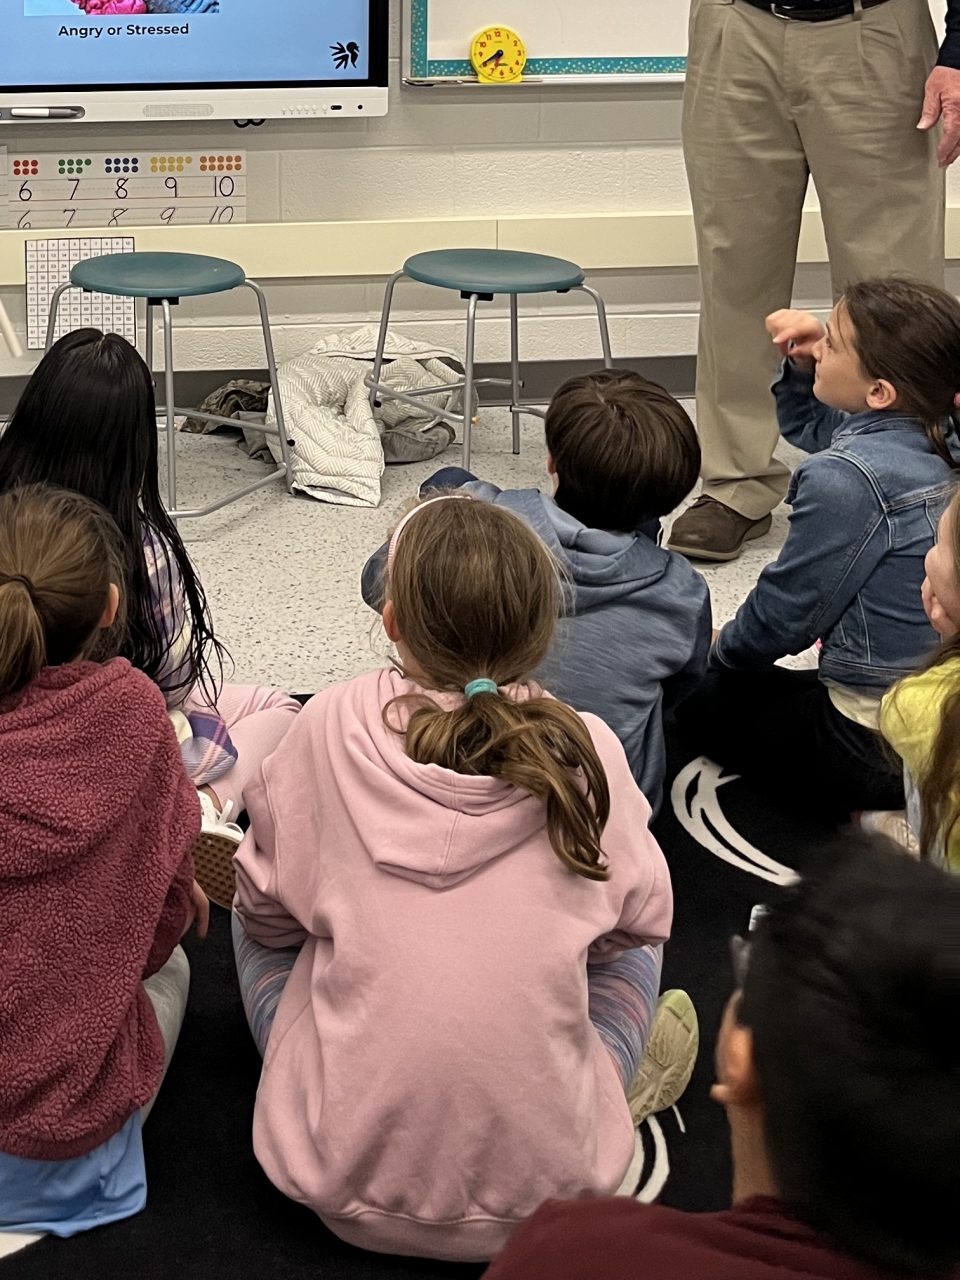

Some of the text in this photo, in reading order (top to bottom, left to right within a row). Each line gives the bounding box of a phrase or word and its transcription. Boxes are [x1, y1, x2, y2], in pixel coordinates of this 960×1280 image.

[58, 23, 189, 38] Angry or Stressed
[19, 180, 32, 201] 6
[68, 178, 80, 200] 7
[115, 178, 129, 199] 8
[165, 176, 178, 198] 9
[214, 175, 235, 197] 10
[17, 210, 31, 229] 6
[63, 208, 78, 228] 7
[108, 208, 129, 227] 8
[160, 207, 175, 224] 9
[209, 205, 234, 224] 10
